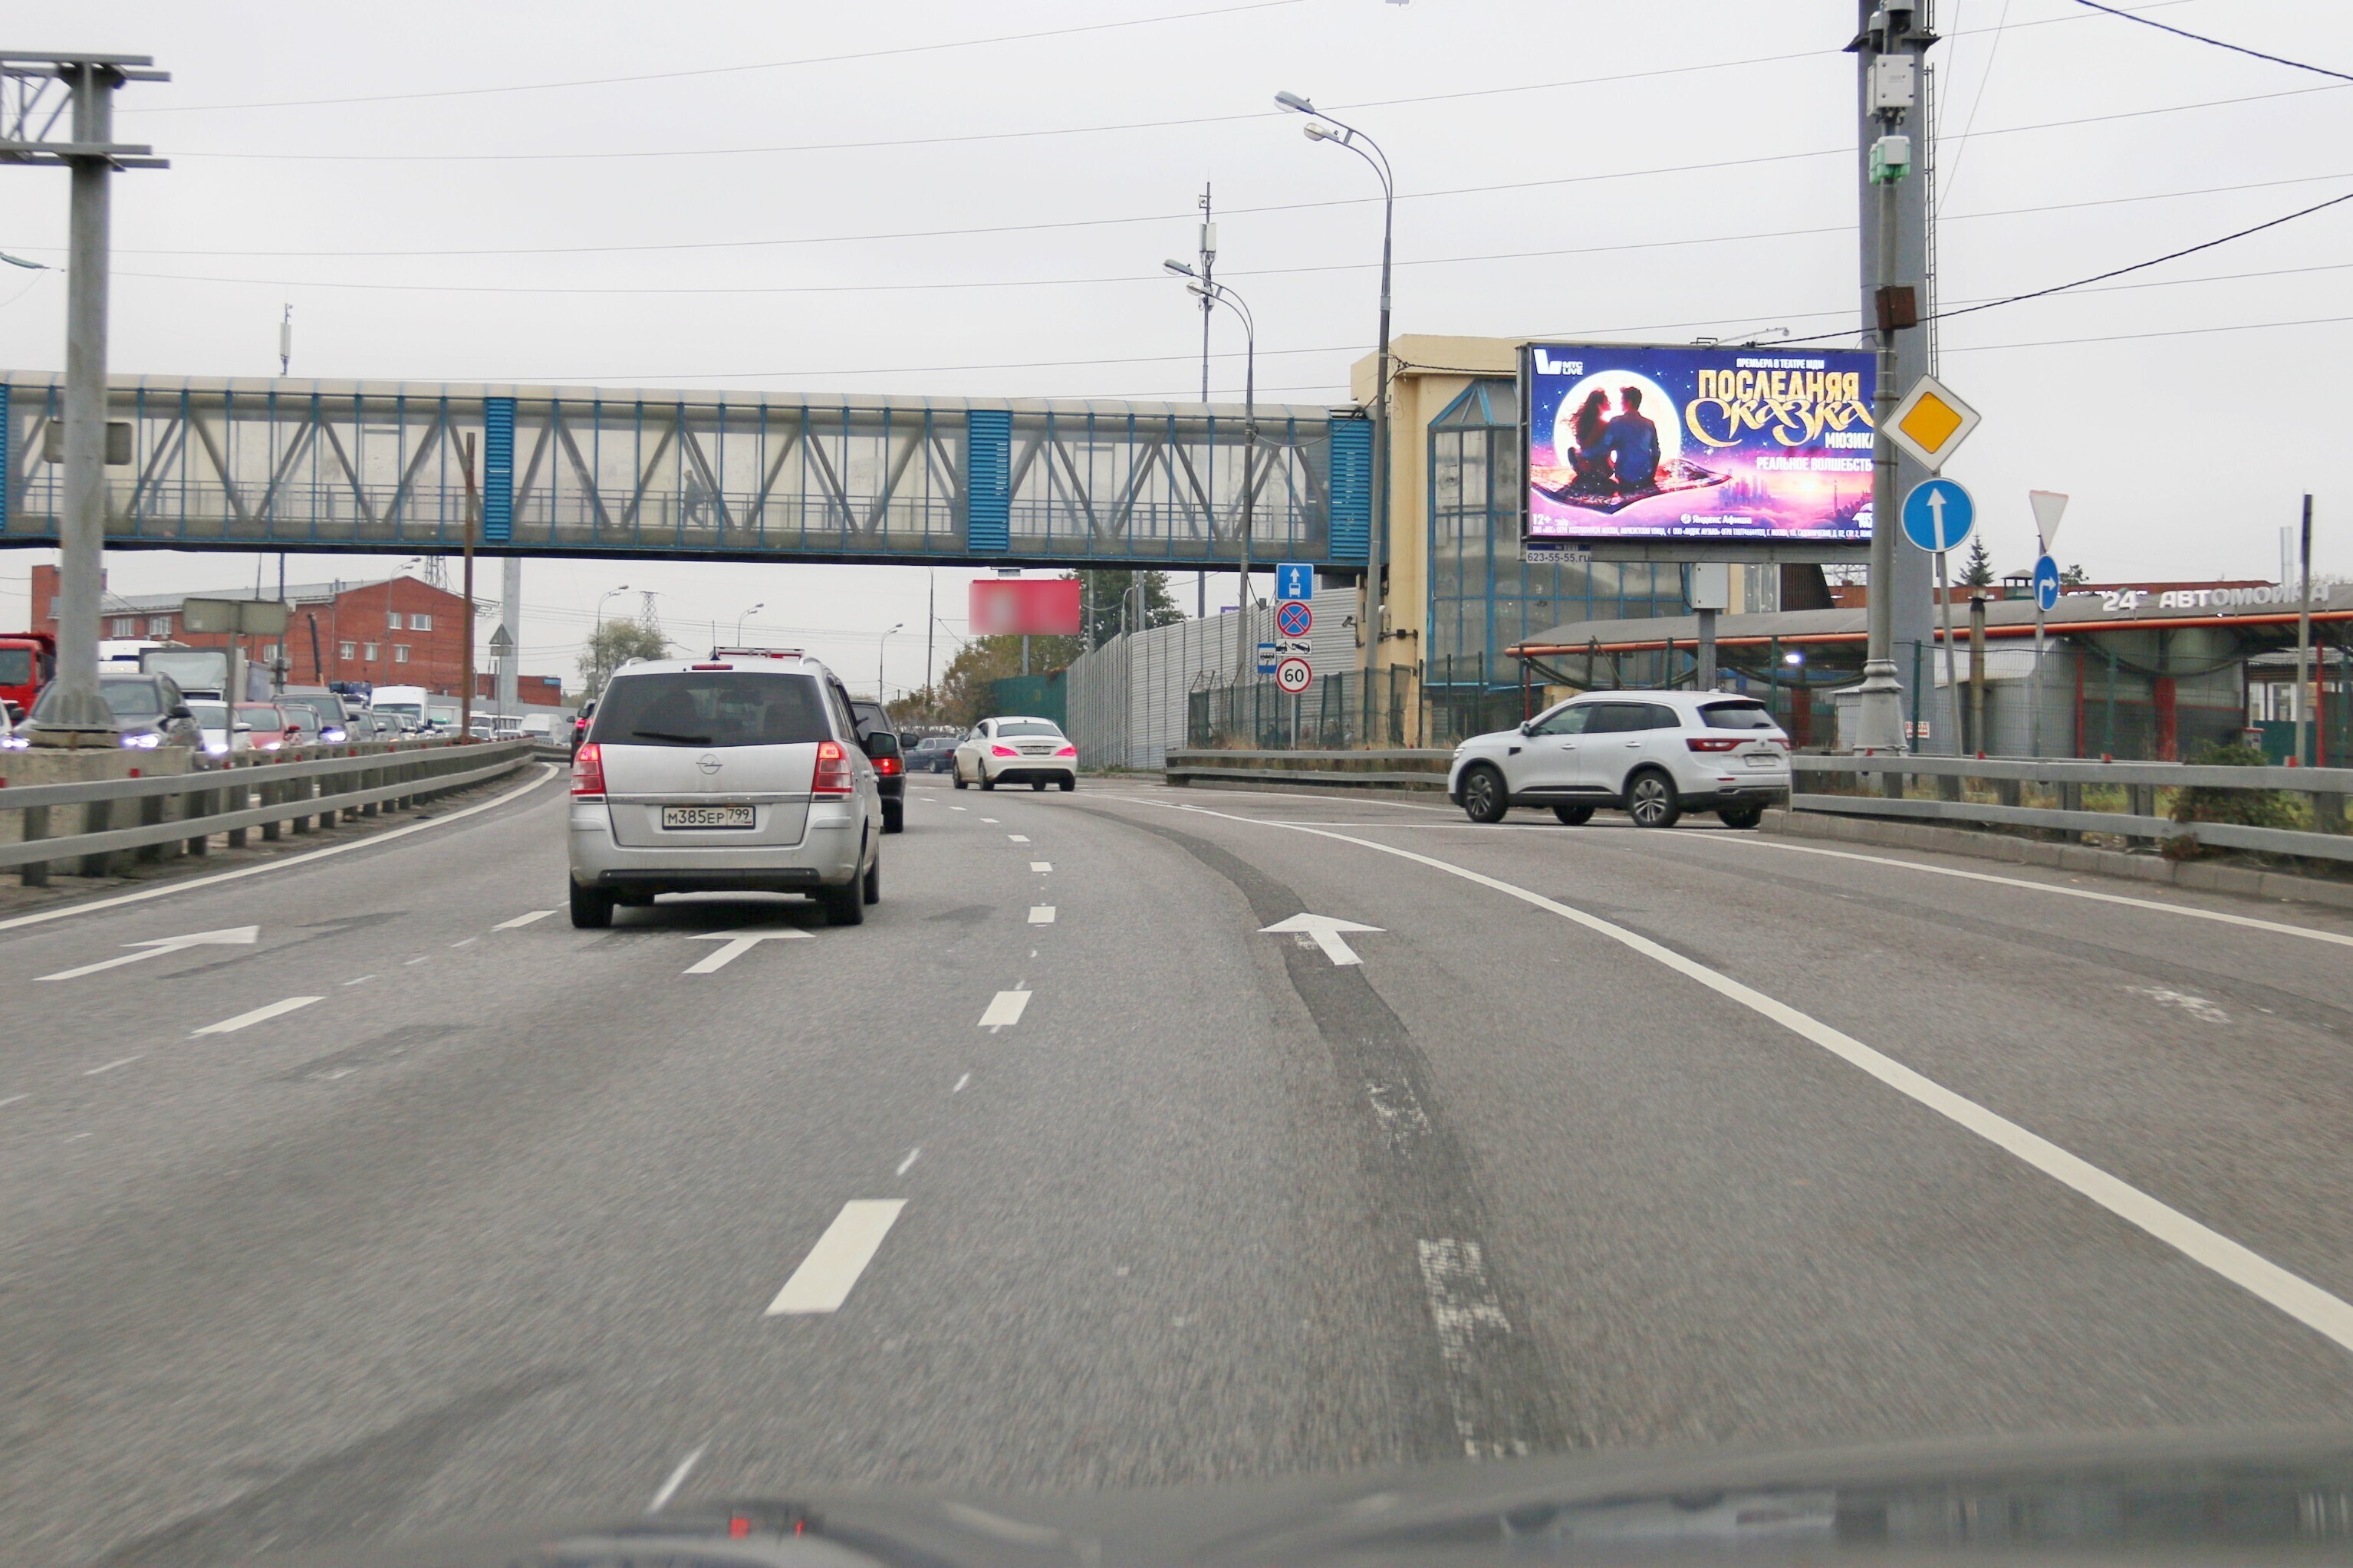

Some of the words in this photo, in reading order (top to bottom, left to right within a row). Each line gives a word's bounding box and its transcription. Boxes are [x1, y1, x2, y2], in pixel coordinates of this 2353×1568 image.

[1736, 358, 1772, 368] ПРЕМЬЕРА
[1774, 359, 1779, 368] В
[1779, 358, 1805, 369] ТЕАТРЕ
[1806, 359, 1825, 370] МДМ
[1698, 369, 1860, 403] ПОСЛЕДНЯЯ
[1756, 457, 1808, 471] РЕАЛЬНОЕ
[1810, 458, 1874, 472] ВОЛШЕБСТВ
[1533, 514, 1552, 525] 12+
[1692, 514, 1722, 525] Яндекс
[1722, 514, 1752, 525] Афиша
[1527, 552, 1590, 563] 623-55-55.ru
[2102, 590, 2139, 612] 24
[1285, 668, 1304, 682] 60
[728, 809, 750, 820] 799
